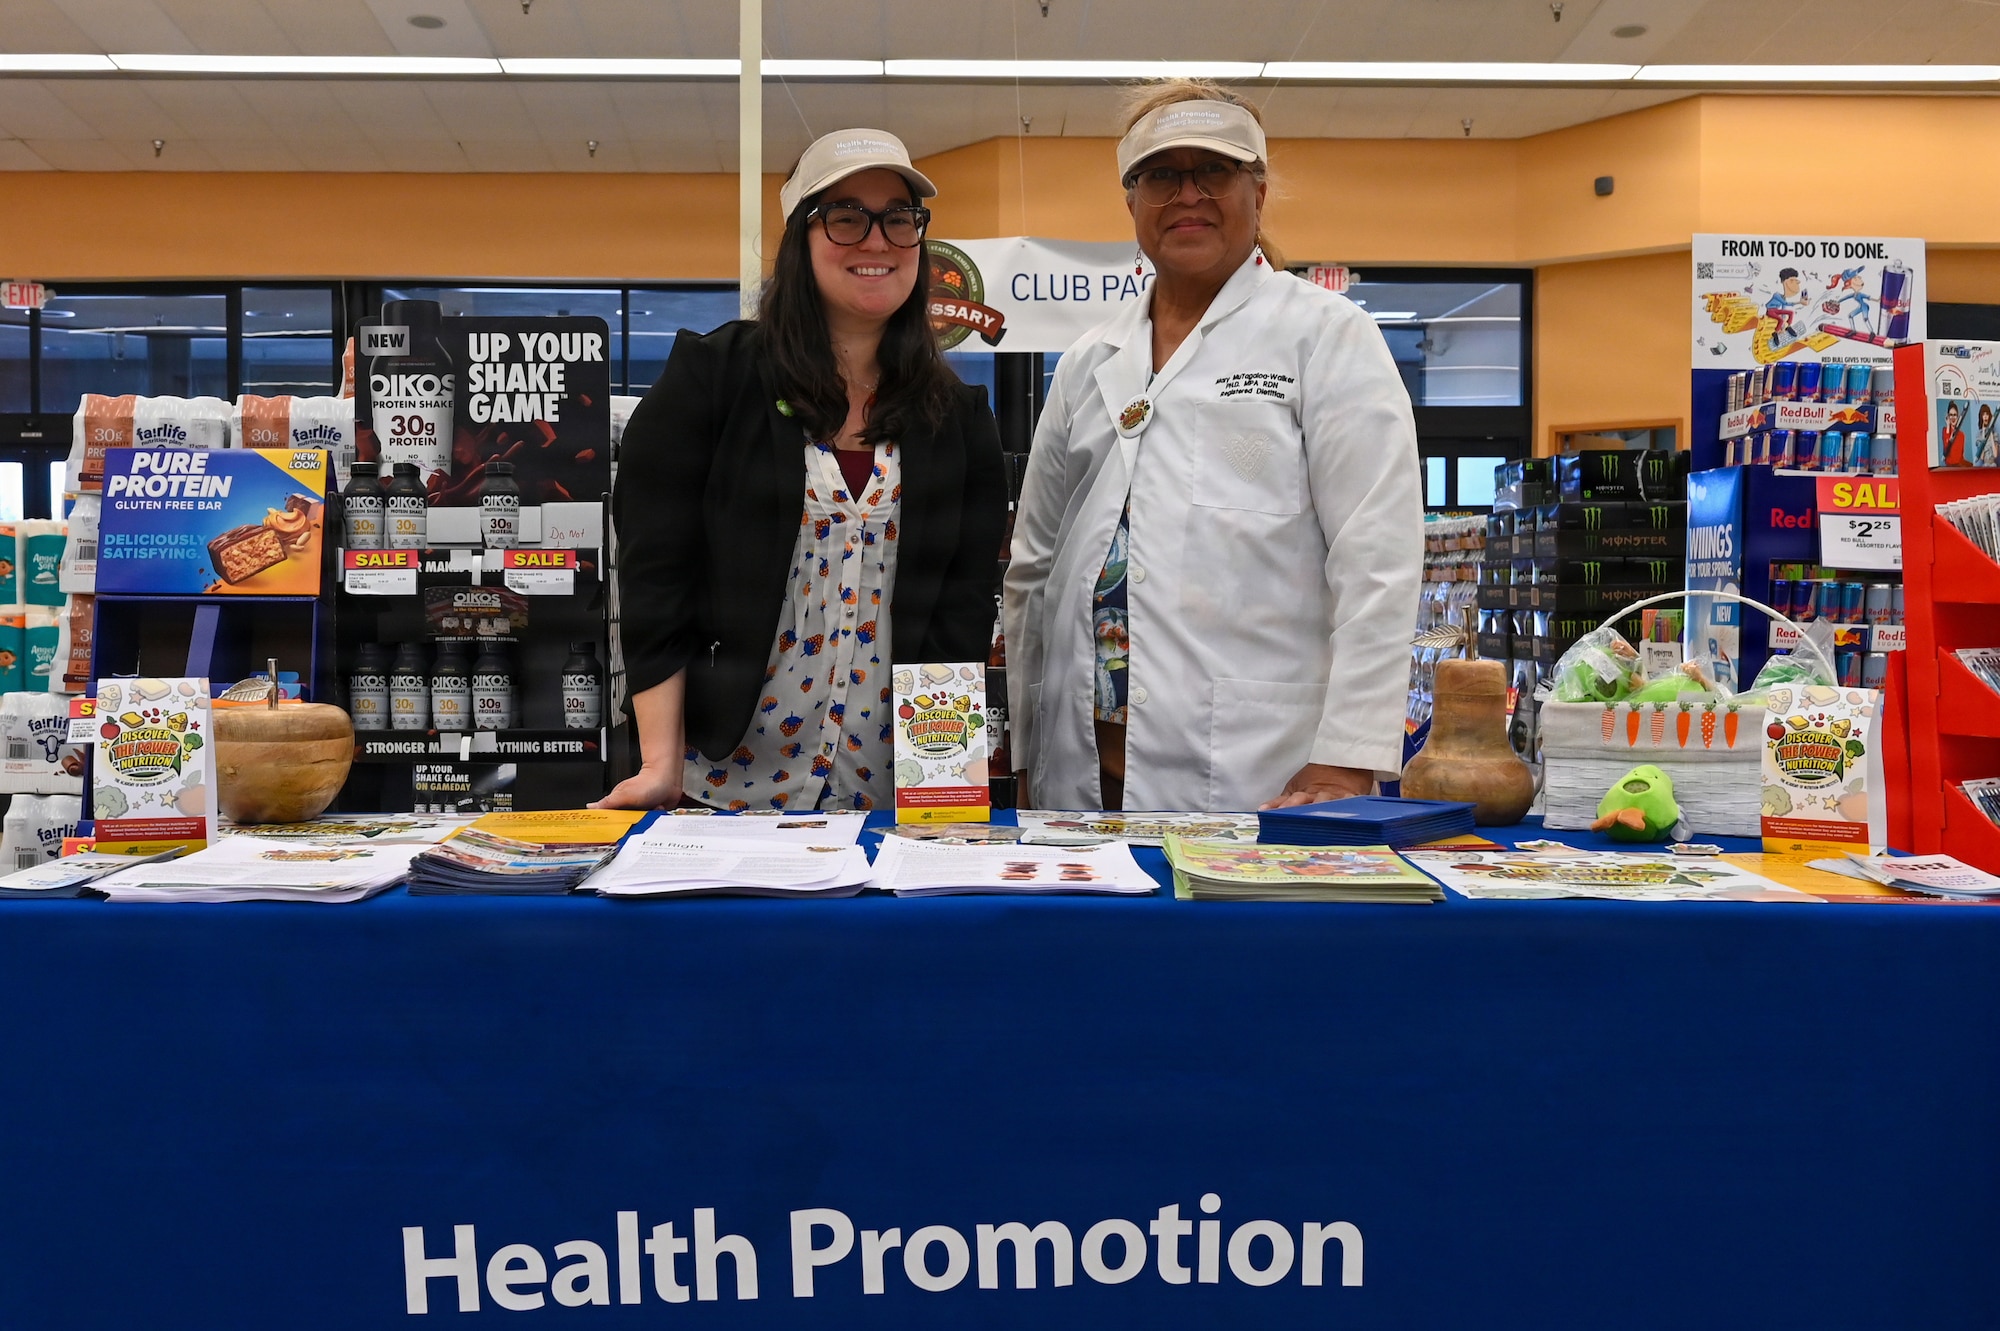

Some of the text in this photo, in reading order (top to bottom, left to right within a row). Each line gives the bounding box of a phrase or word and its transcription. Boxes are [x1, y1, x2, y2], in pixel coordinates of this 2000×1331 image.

[1180, 111, 1220, 119] Promotion
[836, 139, 899, 152] Health Promotion
[931, 245, 952, 255] STATES
[1722, 240, 1889, 259] FROM TO-DO TO DONE.
[1315, 268, 1344, 290] EXIT
[1011, 273, 1091, 302] CLUB
[9, 284, 40, 306] EXIT
[367, 333, 405, 348] NEW
[468, 333, 604, 362] UP YOUR
[468, 363, 565, 393] SHAKE
[370, 373, 456, 397] OIKOS
[1262, 380, 1279, 389] RDN
[1875, 390, 1890, 398] Red
[372, 400, 454, 409] PROTEIN SHAKE
[1780, 406, 1825, 419] Red Bull
[390, 415, 435, 437] 30g
[1727, 413, 1745, 429] Red Bull
[94, 428, 123, 442] 30g
[251, 429, 279, 443] 30g
[141, 438, 168, 447] nutrition
[297, 439, 324, 447] nutrition
[389, 437, 437, 446] PROTEIN
[292, 452, 318, 461] NEW
[130, 452, 210, 474] PURE
[288, 460, 321, 470] LOOK!
[106, 475, 233, 498] PROTEIN
[482, 494, 519, 507] OIKOS
[1583, 490, 1592, 499] 12
[1832, 482, 1899, 509] SAL
[115, 501, 222, 511] GLUTEN FREE BAR
[345, 496, 383, 509] OIKOS
[388, 496, 425, 509] OIKOS
[490, 518, 512, 530] 30g
[1770, 507, 1811, 529] Red
[353, 519, 375, 531] 30g
[396, 519, 417, 531] 30g
[550, 526, 585, 540] Do Not
[104, 533, 207, 546] DELICIOUSLY
[1602, 535, 1668, 547] MONSTER
[32, 553, 58, 564] Angel
[102, 547, 202, 560] SATISFYING.
[37, 561, 55, 571] Soft
[355, 553, 408, 567] SALE
[513, 553, 566, 567] SALE
[1697, 562, 1711, 577] YOUR
[1711, 560, 1734, 577] SPRING.
[453, 592, 500, 604] OIKOS
[1716, 605, 1732, 623] NEW
[1868, 608, 1883, 616] Red
[1776, 627, 1796, 639] Red
[1878, 630, 1899, 641] Red
[30, 645, 56, 656] Angel
[390, 675, 424, 687] OIKOS
[431, 676, 468, 688] OIKOS
[471, 674, 510, 687] OIKOS
[354, 698, 376, 709] 30g
[394, 698, 414, 709] 30g
[439, 699, 459, 711] 30g
[478, 698, 501, 709] 30g
[566, 697, 585, 709] 30g
[916, 710, 958, 722] DISCOVER
[32, 728, 60, 737] nutrition
[909, 721, 965, 736] THE POWER
[121, 729, 171, 743] DISCOVER
[916, 734, 960, 746] NUTRITION
[1785, 733, 1834, 745] DISCOVER
[112, 741, 180, 759] THE POWER
[365, 742, 426, 754] STRONGER
[543, 741, 584, 753] BETTER
[1778, 744, 1842, 760] THE POWER
[120, 756, 173, 769] NUTRITION
[1785, 760, 1835, 772] NUTRITION
[416, 764, 453, 774] UP YOUR
[415, 773, 470, 783] SHAKE GAME
[415, 783, 472, 792] ON GAMEDAY
[402, 1191, 1364, 1315] Health Promotion
